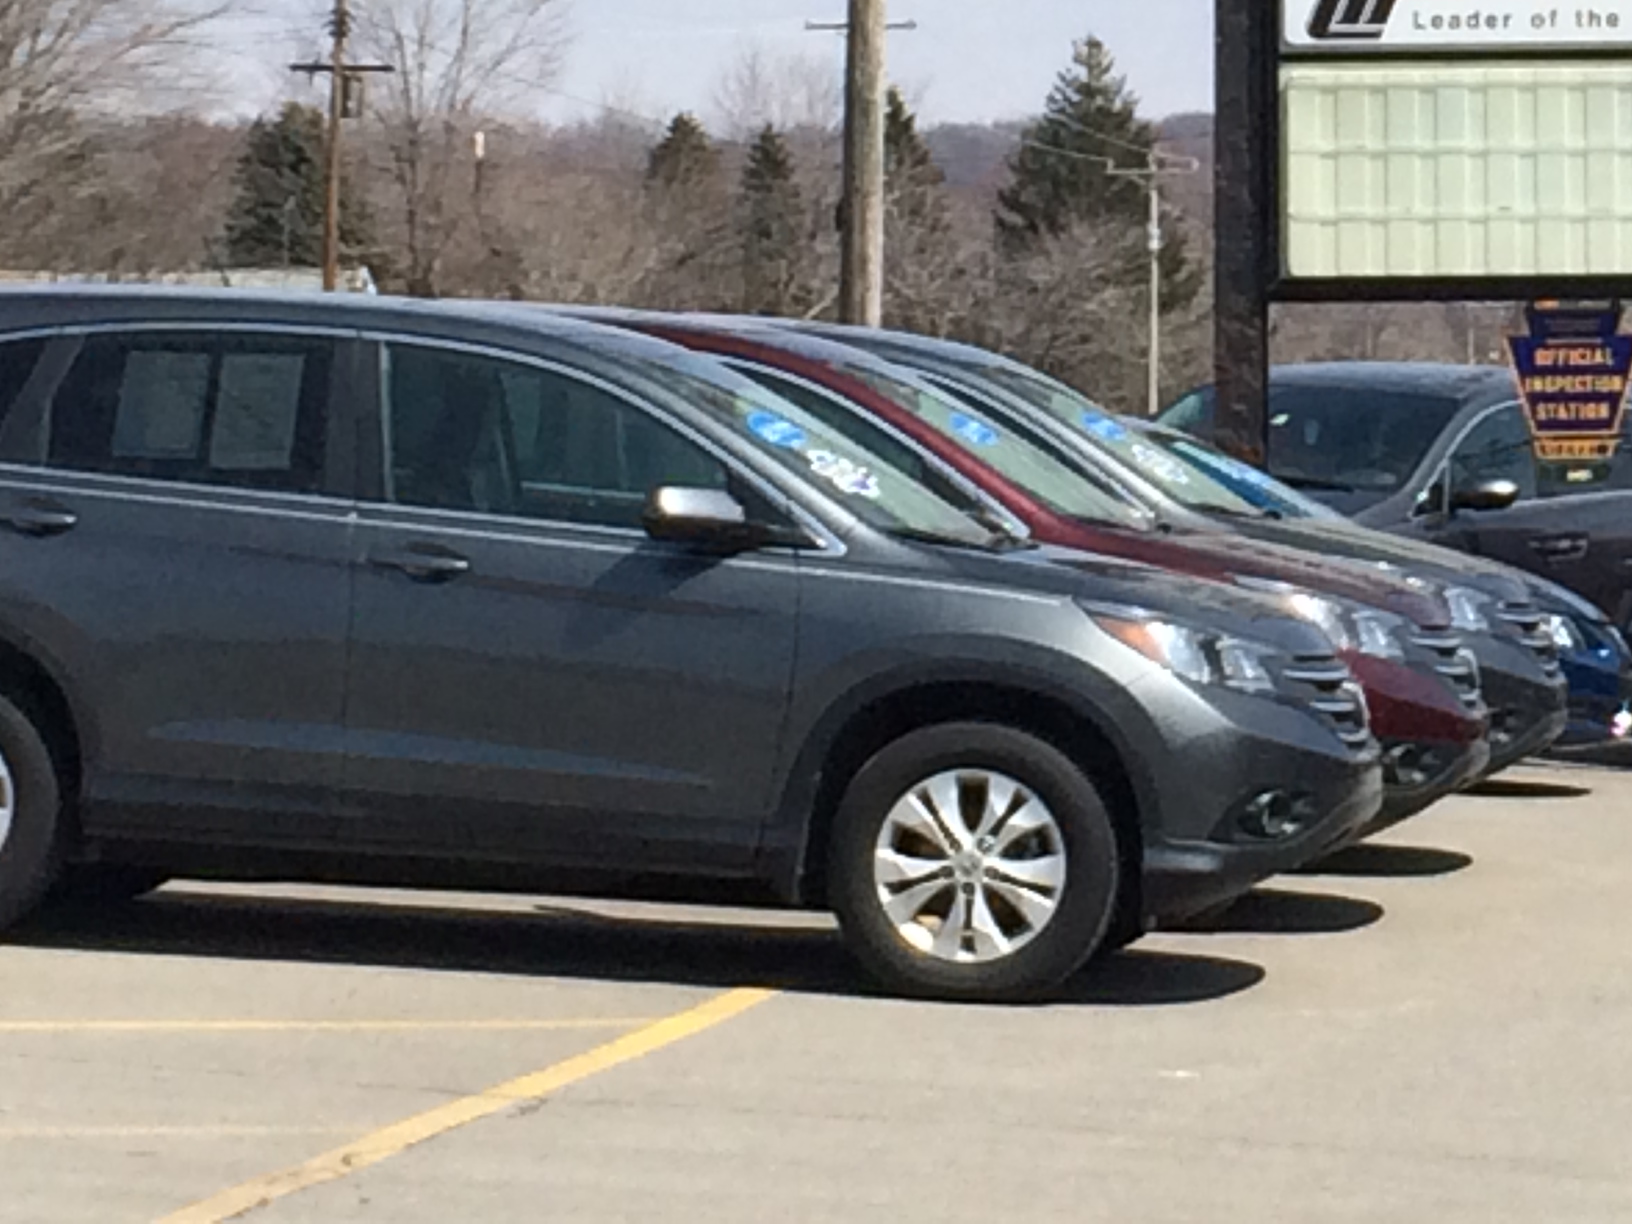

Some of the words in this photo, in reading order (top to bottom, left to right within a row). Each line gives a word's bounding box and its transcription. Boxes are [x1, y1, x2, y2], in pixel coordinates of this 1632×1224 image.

[1412, 10, 1512, 30] Leader
[1530, 10, 1557, 29] of
[1575, 9, 1620, 28] the
[1533, 347, 1615, 367] OFFICIAL
[1524, 376, 1624, 393] INSPECTION
[1535, 402, 1610, 421] STATION
